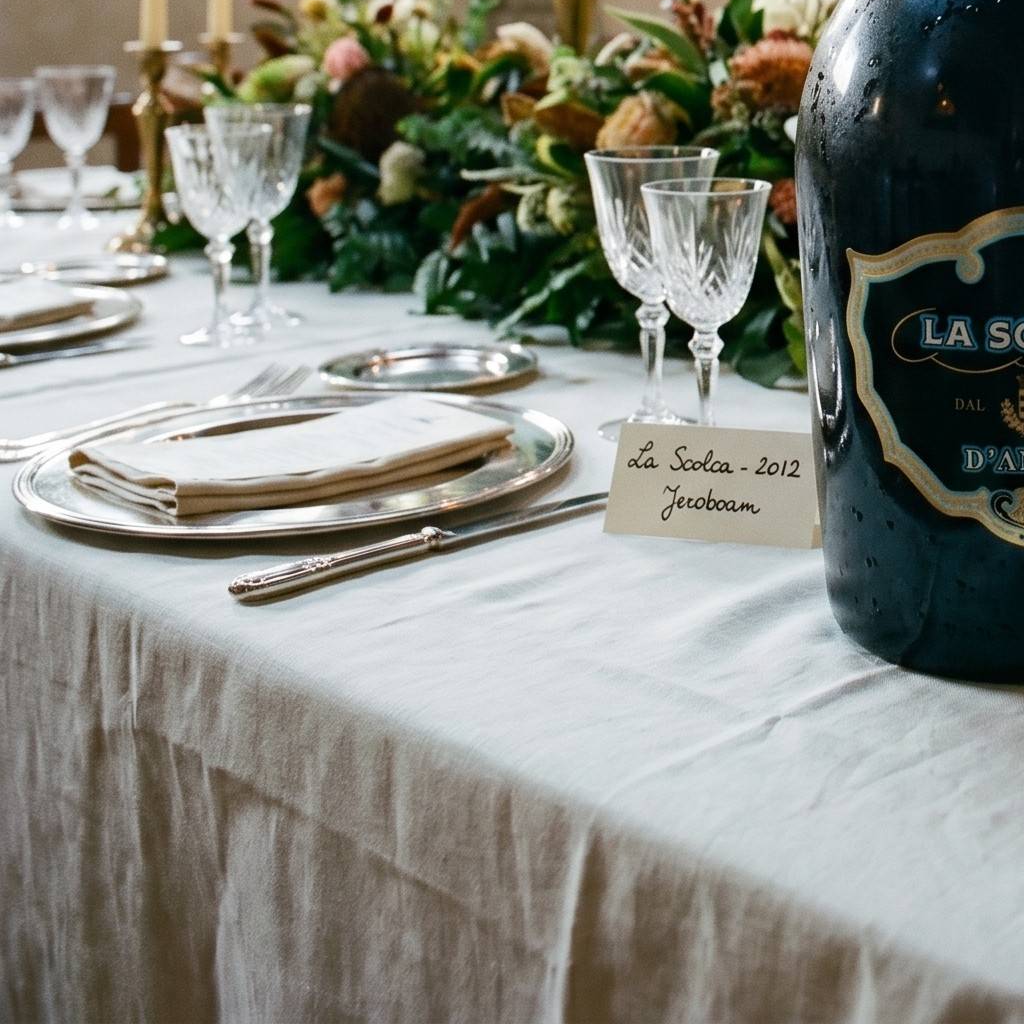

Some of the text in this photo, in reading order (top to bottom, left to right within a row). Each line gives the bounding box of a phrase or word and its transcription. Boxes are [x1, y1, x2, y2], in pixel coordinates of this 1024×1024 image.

[922, 317, 976, 350] LA
[954, 397, 986, 412] DAL
[626, 440, 660, 470] La
[669, 445, 735, 474] Scolca
[754, 456, 802, 478] 2012
[660, 484, 761, 522] Jeroboam
